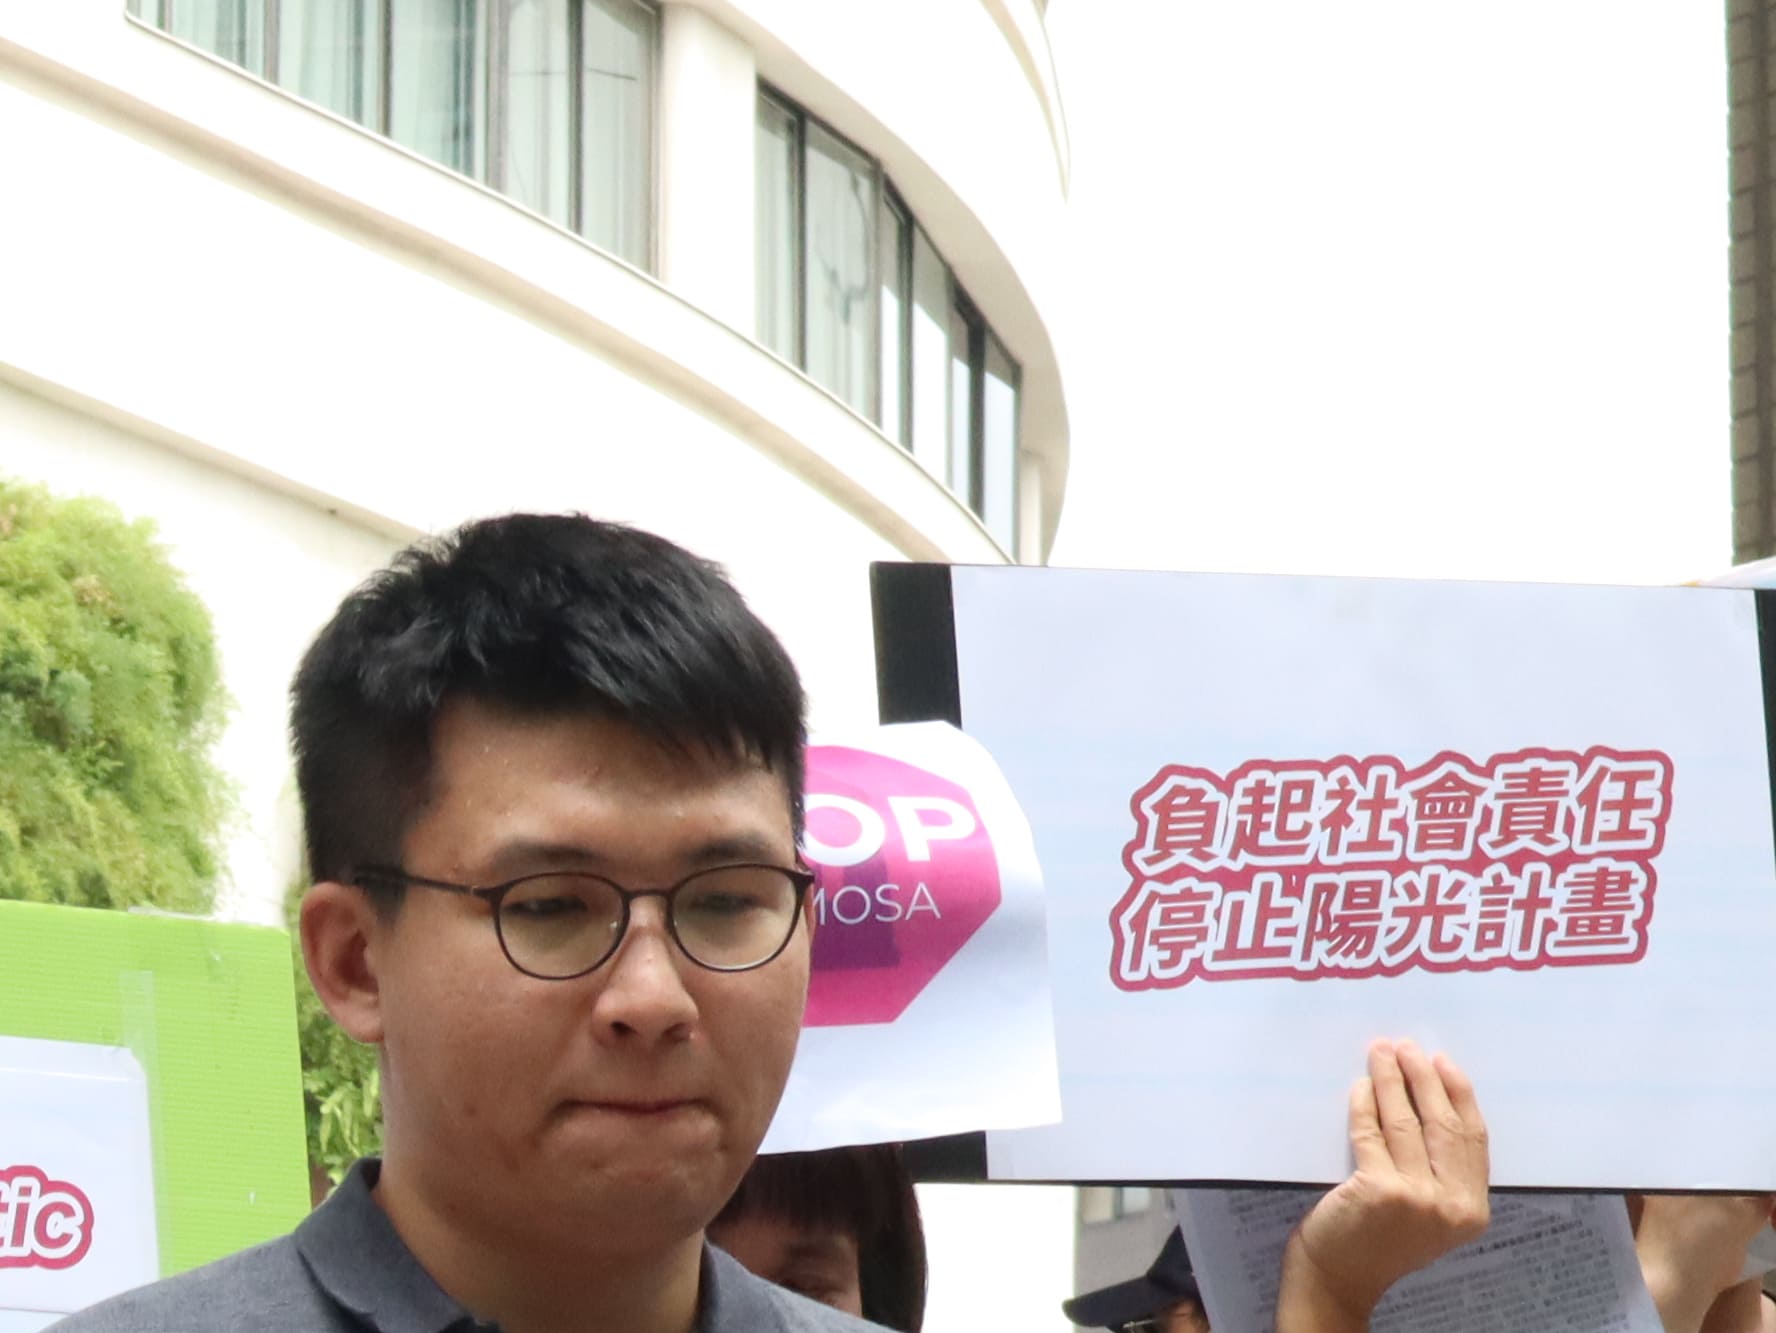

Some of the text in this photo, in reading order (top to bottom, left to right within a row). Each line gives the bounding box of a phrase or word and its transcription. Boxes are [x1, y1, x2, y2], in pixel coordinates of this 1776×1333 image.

[800, 794, 976, 867] OP
[1138, 758, 1662, 872] 負起社會責任
[1118, 862, 1644, 980] 停止陽光計畫
